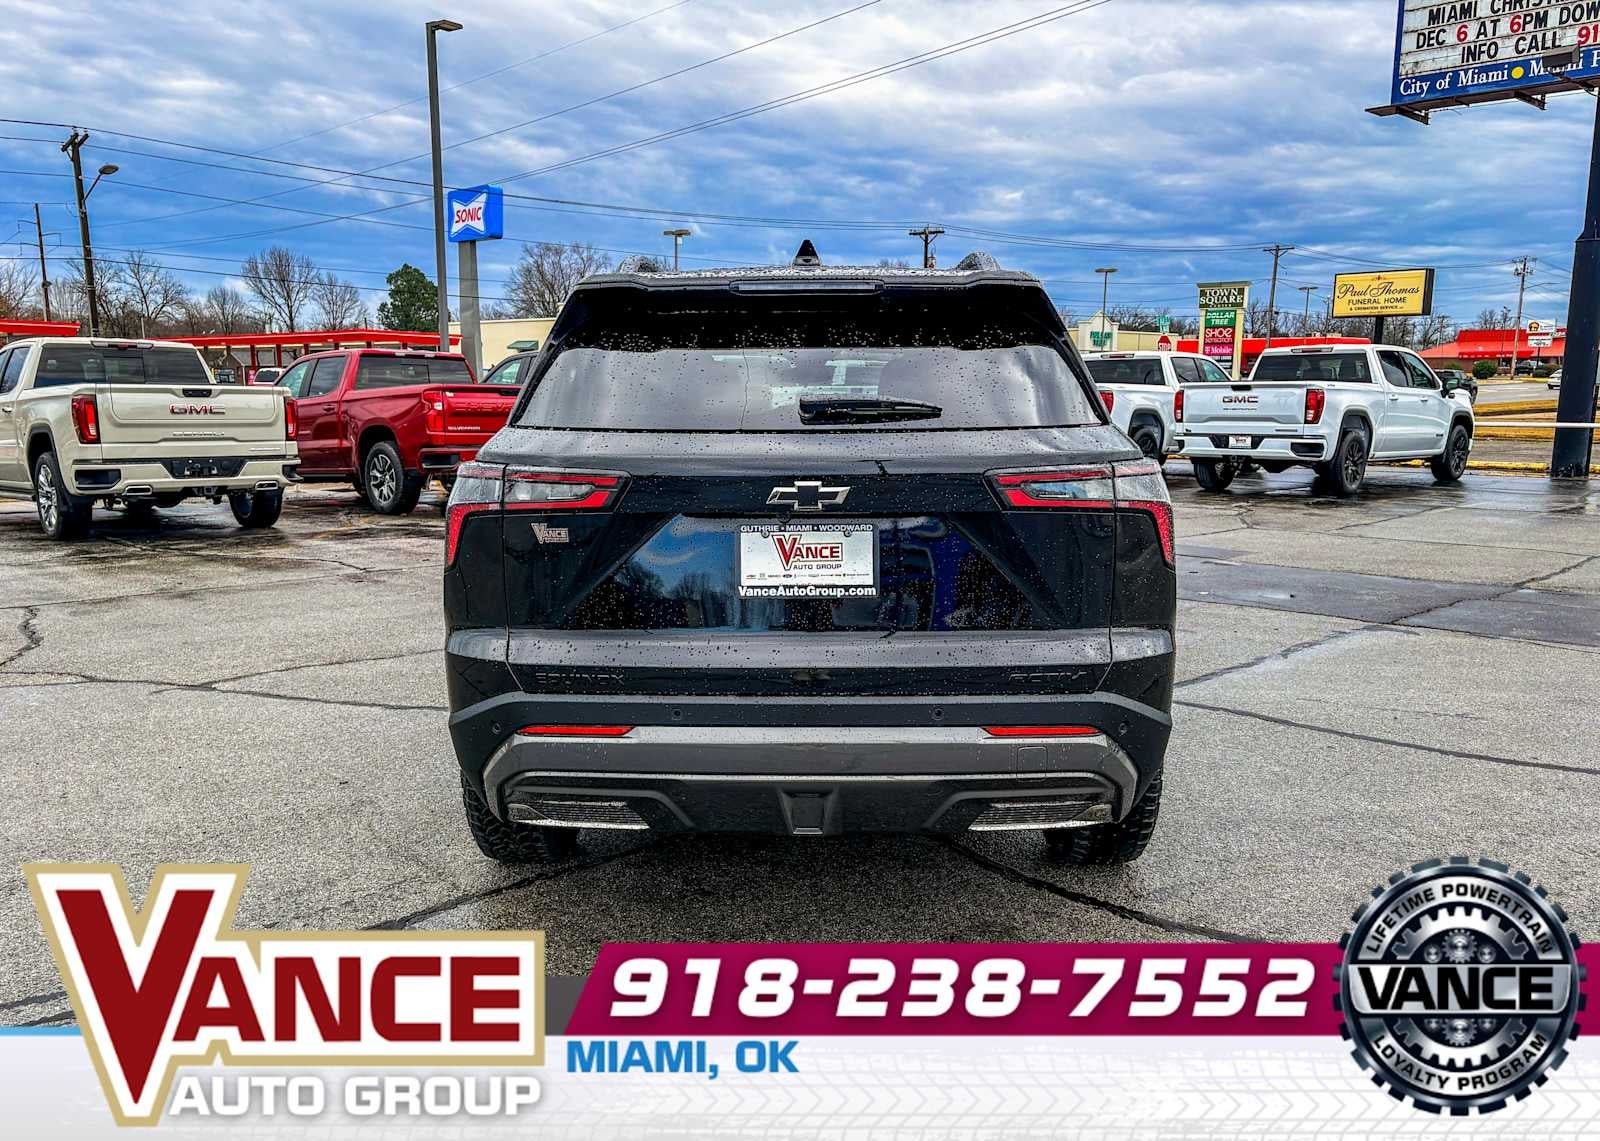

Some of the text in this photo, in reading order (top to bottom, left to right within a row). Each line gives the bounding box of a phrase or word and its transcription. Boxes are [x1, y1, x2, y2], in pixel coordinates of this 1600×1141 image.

[1428, 1, 1478, 26] MIAMI
[1416, 28, 1447, 49] DEC
[1456, 24, 1469, 43] 6
[1476, 19, 1501, 39] AT
[1509, 10, 1549, 33] 6PM
[1461, 41, 1499, 63] INFO
[1514, 31, 1561, 54] CALL
[1400, 79, 1431, 97] City
[1436, 72, 1453, 90] of
[1457, 65, 1509, 87] Miami
[455, 207, 482, 224] SONIC
[1205, 288, 1238, 297] TOWN
[1337, 281, 1420, 299] Paul Thomas
[1200, 295, 1243, 305] SQUARE
[1348, 296, 1407, 306] FUNERAL HOME
[1206, 311, 1235, 319] DOLLAR
[1222, 396, 1259, 404] GMC
[169, 405, 226, 415] GMC
[531, 523, 568, 544] VANCE
[775, 536, 841, 568] VANCE
[738, 586, 877, 597] VanceAutoGroup.com
